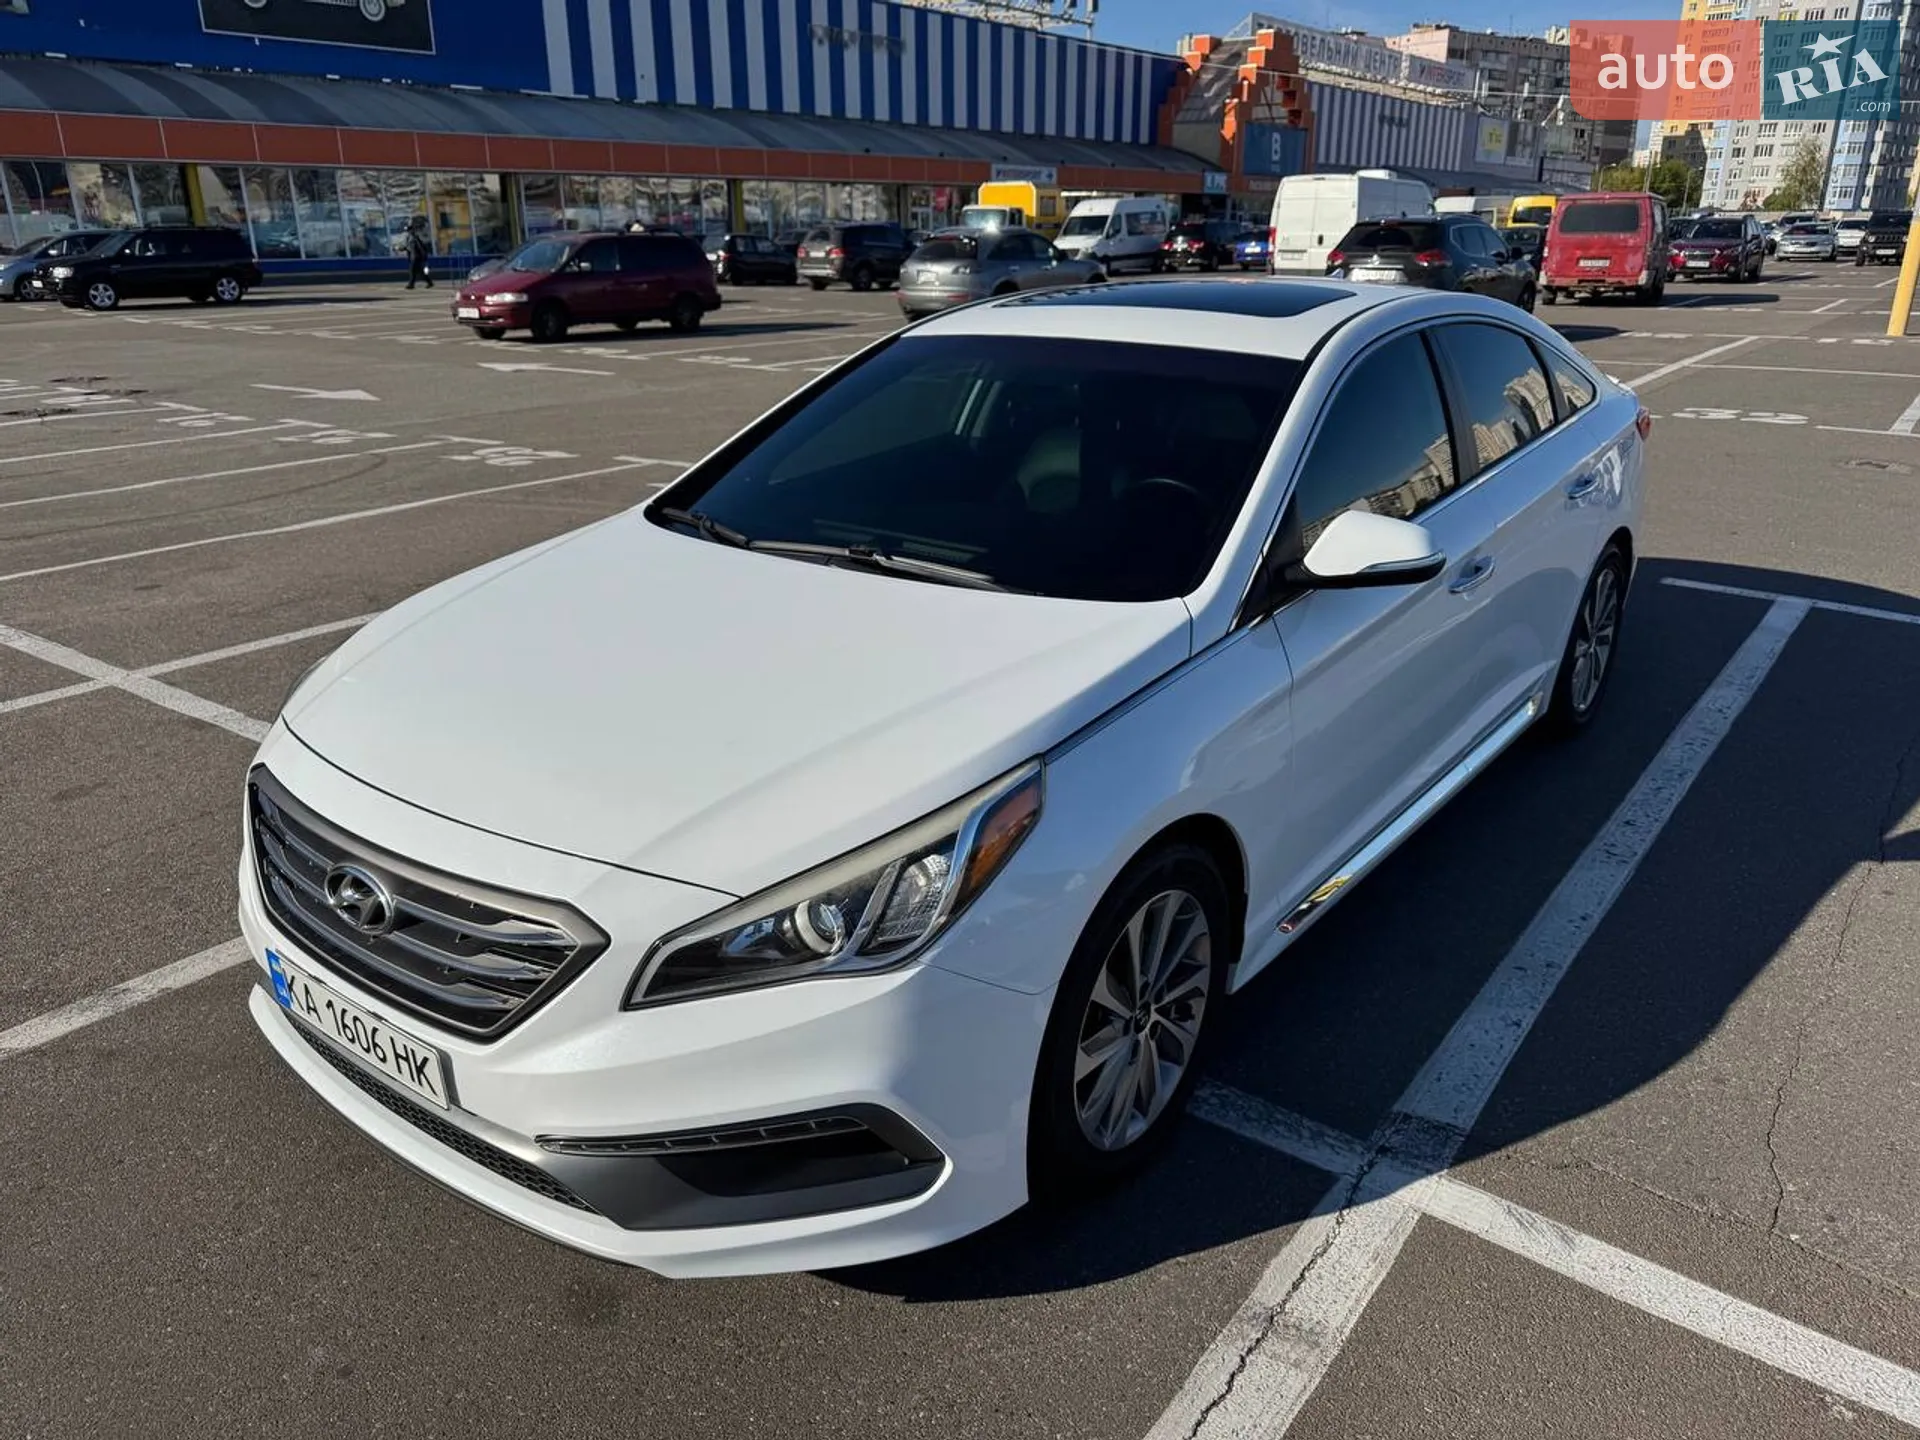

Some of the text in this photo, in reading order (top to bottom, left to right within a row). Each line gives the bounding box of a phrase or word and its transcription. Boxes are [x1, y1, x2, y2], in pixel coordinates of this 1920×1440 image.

[282, 967, 438, 1098] KA 1606 HK
